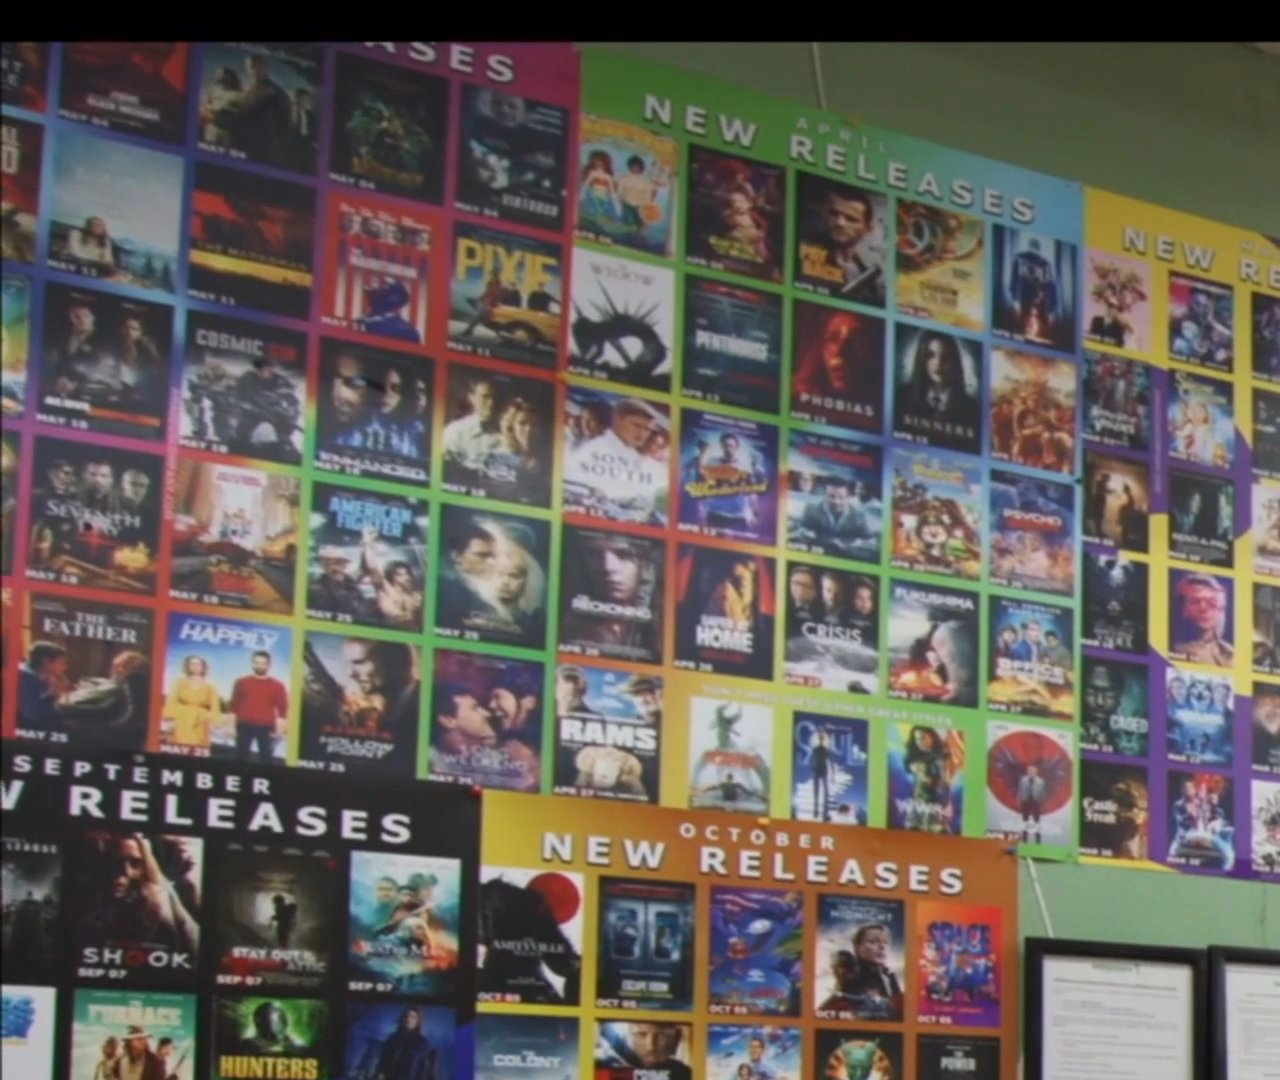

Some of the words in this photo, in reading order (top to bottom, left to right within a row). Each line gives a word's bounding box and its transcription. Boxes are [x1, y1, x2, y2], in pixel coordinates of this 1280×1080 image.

[796, 117, 886, 153] APRIL
[644, 94, 756, 148] NEW
[790, 134, 1036, 224] RELEASES
[1122, 226, 1215, 273] NEW
[456, 237, 560, 293] PIXIE
[196, 329, 264, 356] COSMIC
[800, 391, 875, 417] PHOBIAS
[903, 413, 974, 438] SINNERS
[579, 461, 654, 486] SOUTH
[329, 496, 412, 523] AMERICAN
[1003, 508, 1062, 527] PSYCHO
[894, 586, 974, 611] FUKUSHIMA
[43, 616, 138, 645] FATHER
[75, 611, 106, 625] THE
[180, 621, 281, 649] HAPPILY
[696, 625, 754, 653] HOME
[802, 621, 863, 645] CRISIS
[320, 735, 395, 755] HOLLOW
[560, 717, 658, 751] RAMS
[326, 744, 387, 762] POINT
[13, 755, 272, 795] SEPTEMBER
[69, 785, 413, 845] RELEASES
[679, 822, 836, 850] OCTOBER
[541, 831, 665, 869] NEW
[700, 846, 965, 894] RELEASES
[830, 909, 892, 922] MIDNIGHT
[82, 946, 192, 971] SHOOK
[232, 947, 267, 960] STAY
[493, 938, 566, 955] AMITYVILLE
[78, 966, 101, 978] SEP
[104, 967, 128, 980] 07
[216, 974, 242, 985] SEP
[245, 975, 263, 986] 07
[88, 1005, 183, 1027] FURNACE
[493, 1054, 562, 1069] COLONY
[940, 1057, 977, 1071] POWER
